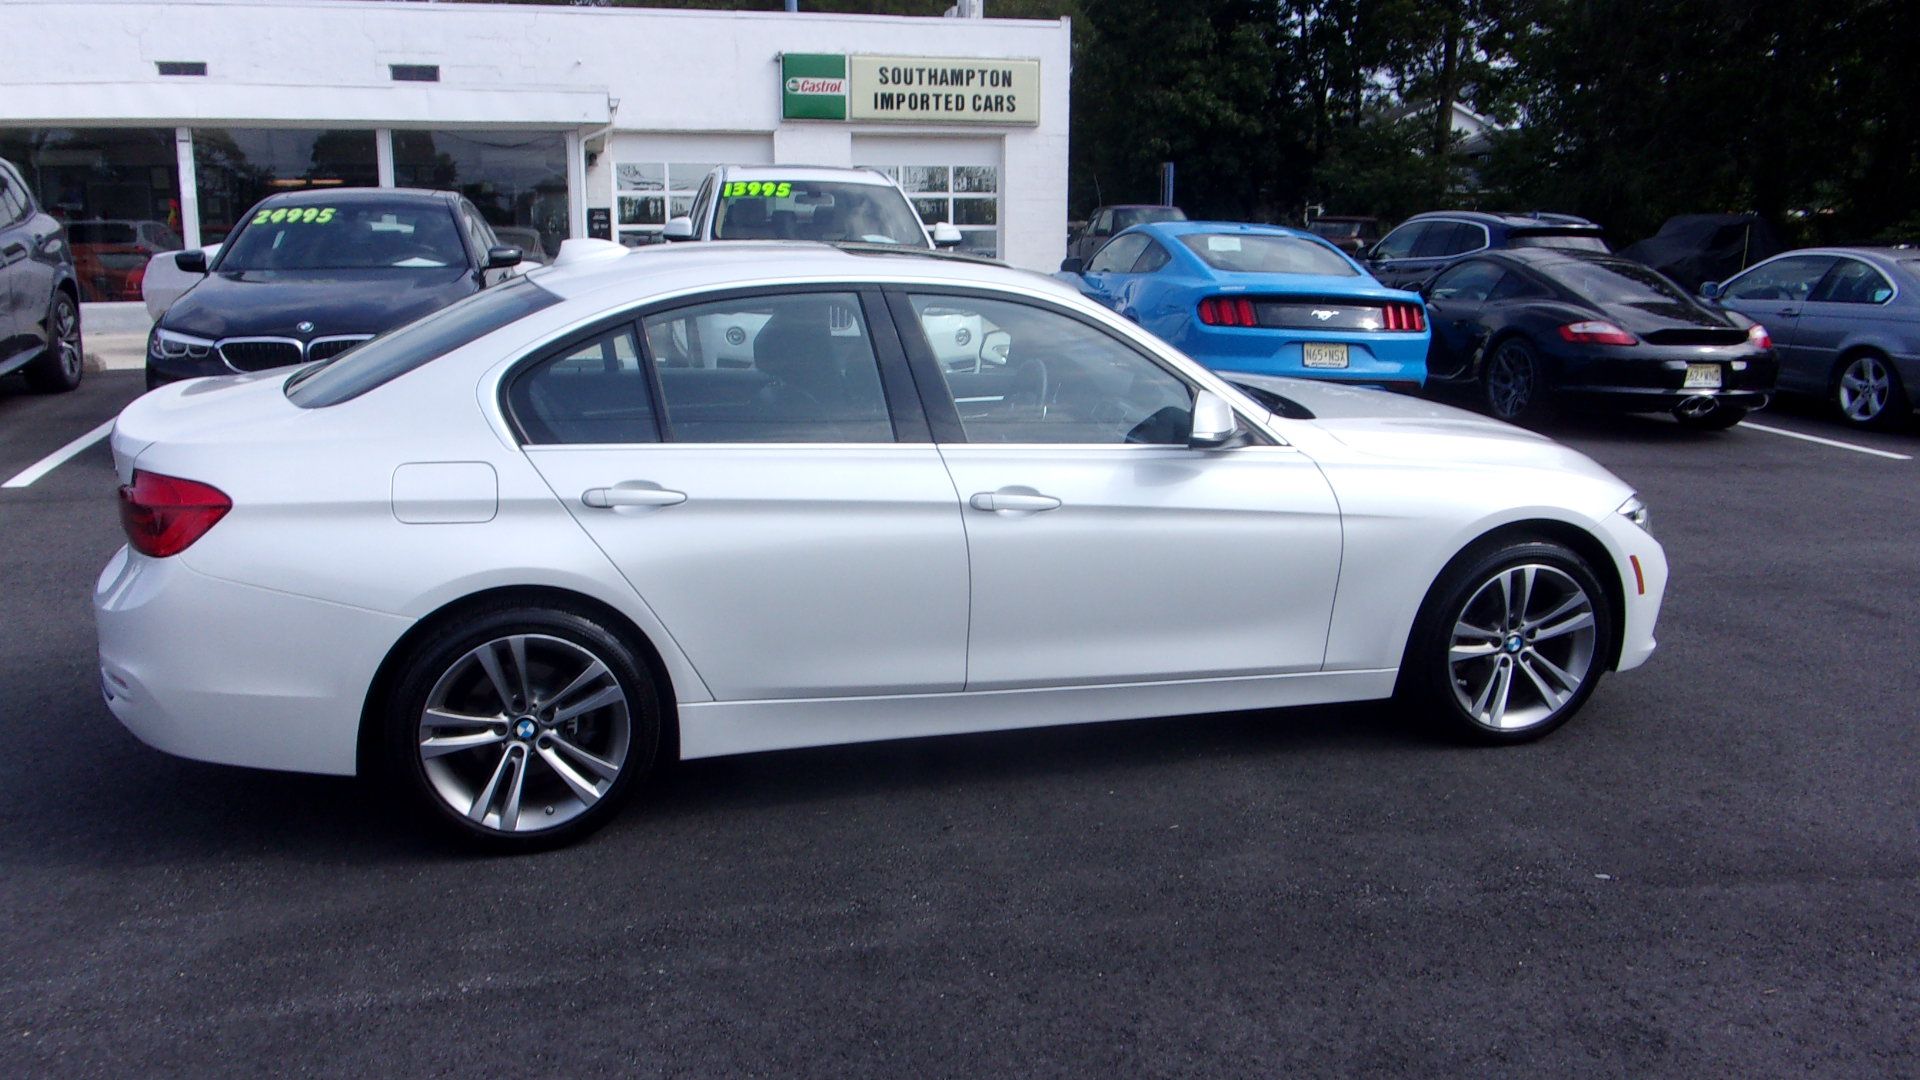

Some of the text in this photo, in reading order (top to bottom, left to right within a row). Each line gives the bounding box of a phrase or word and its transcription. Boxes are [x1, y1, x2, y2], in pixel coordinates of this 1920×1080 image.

[879, 66, 1012, 87] SOUTHAMPTON
[801, 80, 842, 92] Castrol
[874, 92, 1016, 114] IMPORTED CARS
[723, 181, 792, 198] 13995
[252, 208, 336, 224] 24995
